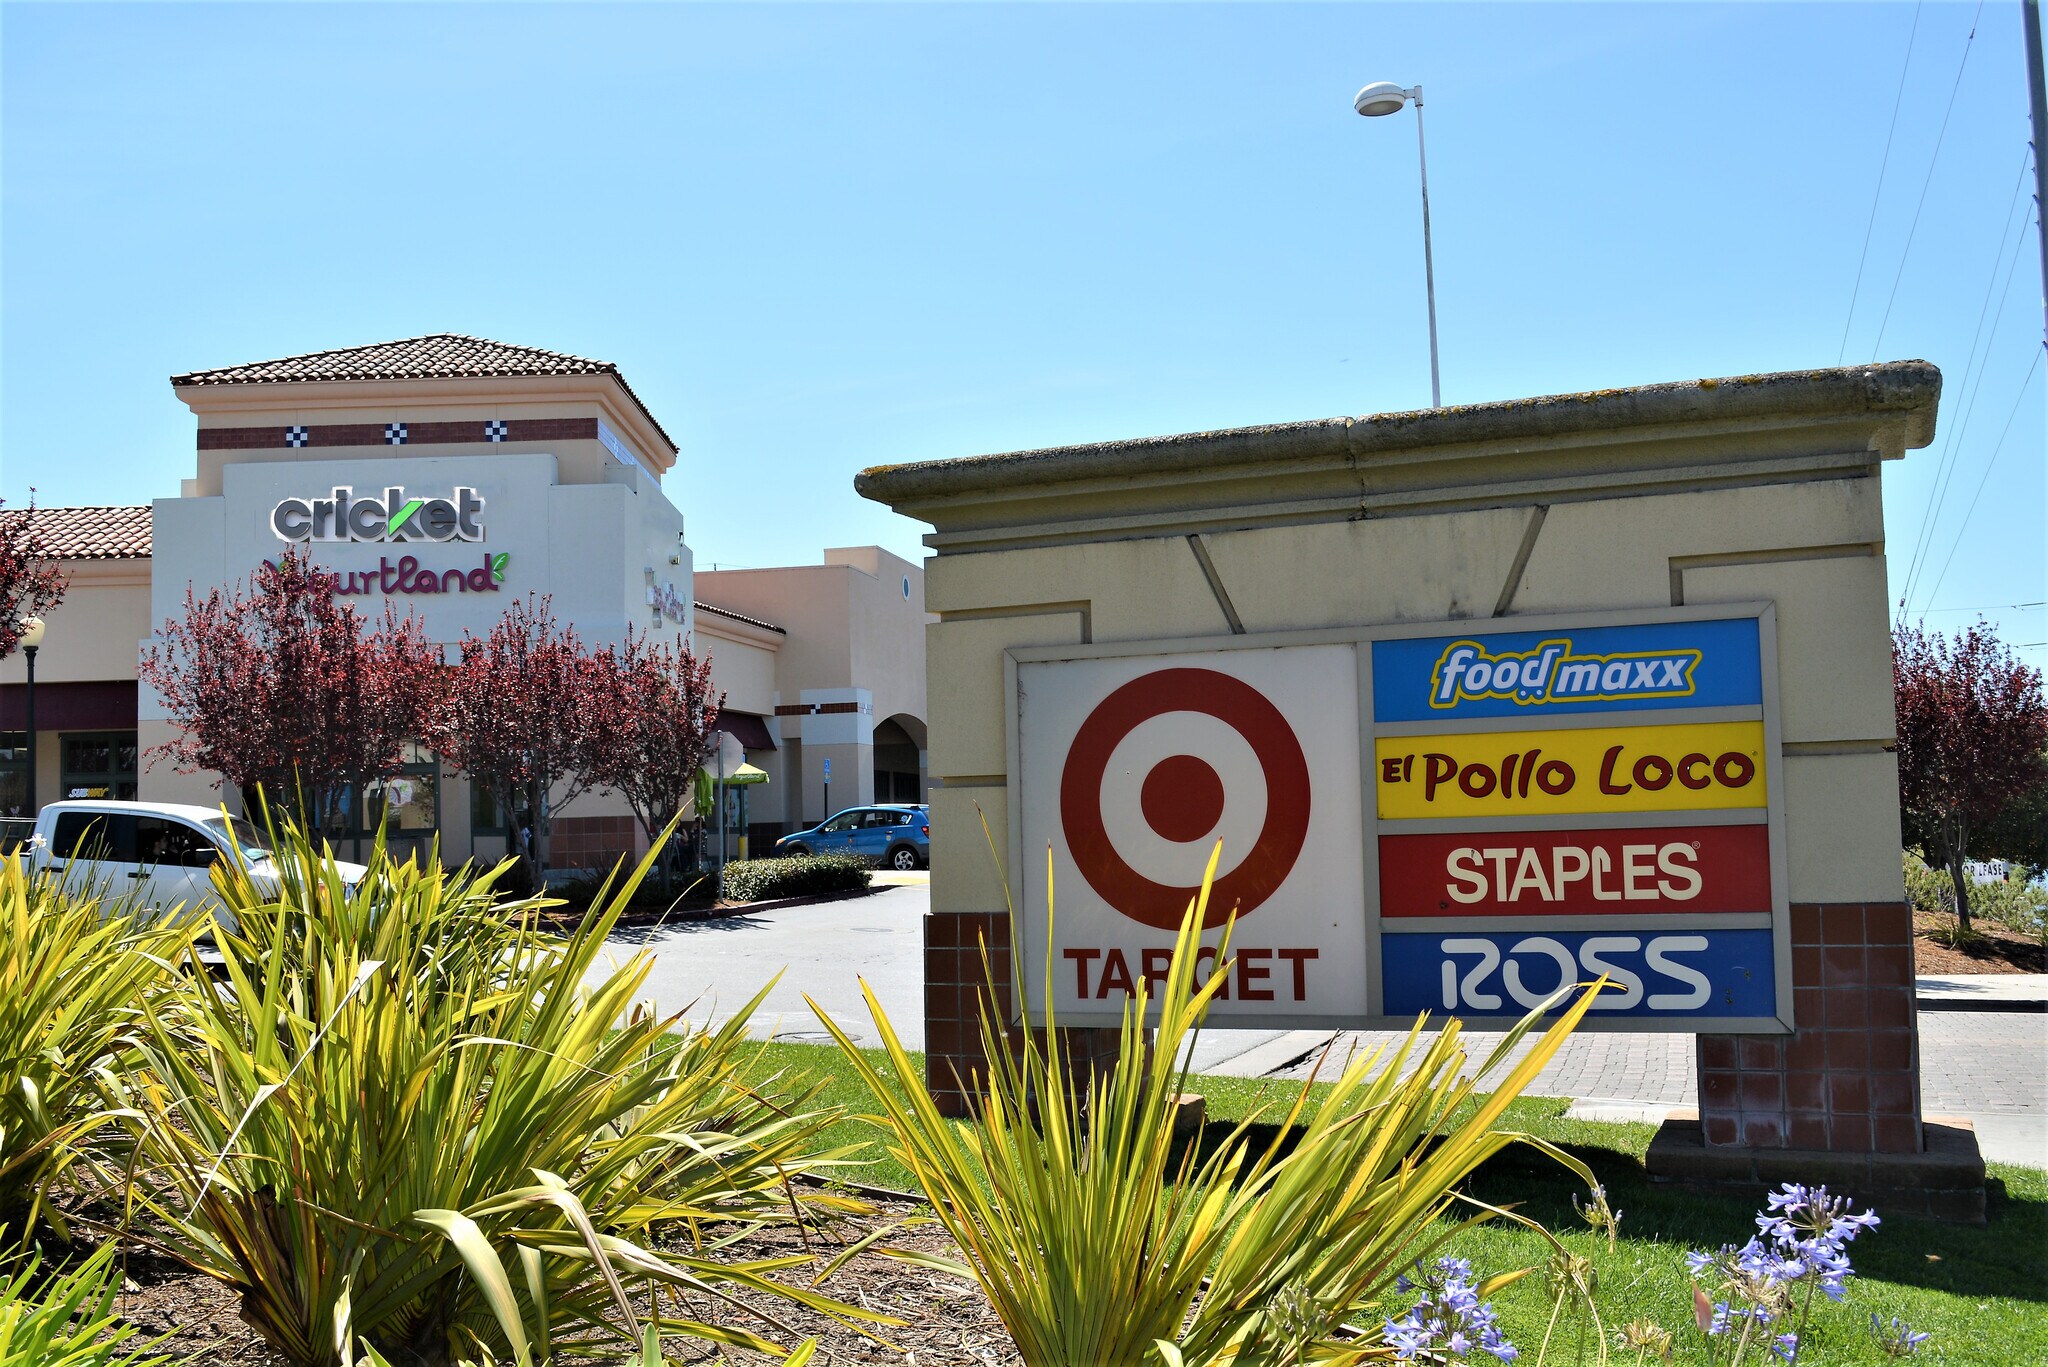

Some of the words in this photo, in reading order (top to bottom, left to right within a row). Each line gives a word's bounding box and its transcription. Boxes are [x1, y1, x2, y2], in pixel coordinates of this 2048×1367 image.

[273, 488, 481, 539] cricket
[263, 552, 500, 612] urtland
[1382, 754, 1415, 783] El
[1423, 748, 1576, 802] Pollo
[1599, 745, 1755, 796] Loco
[1446, 842, 1703, 904] STAPLES
[1962, 865, 1976, 876] OR
[1440, 935, 1712, 1010] ROSS
